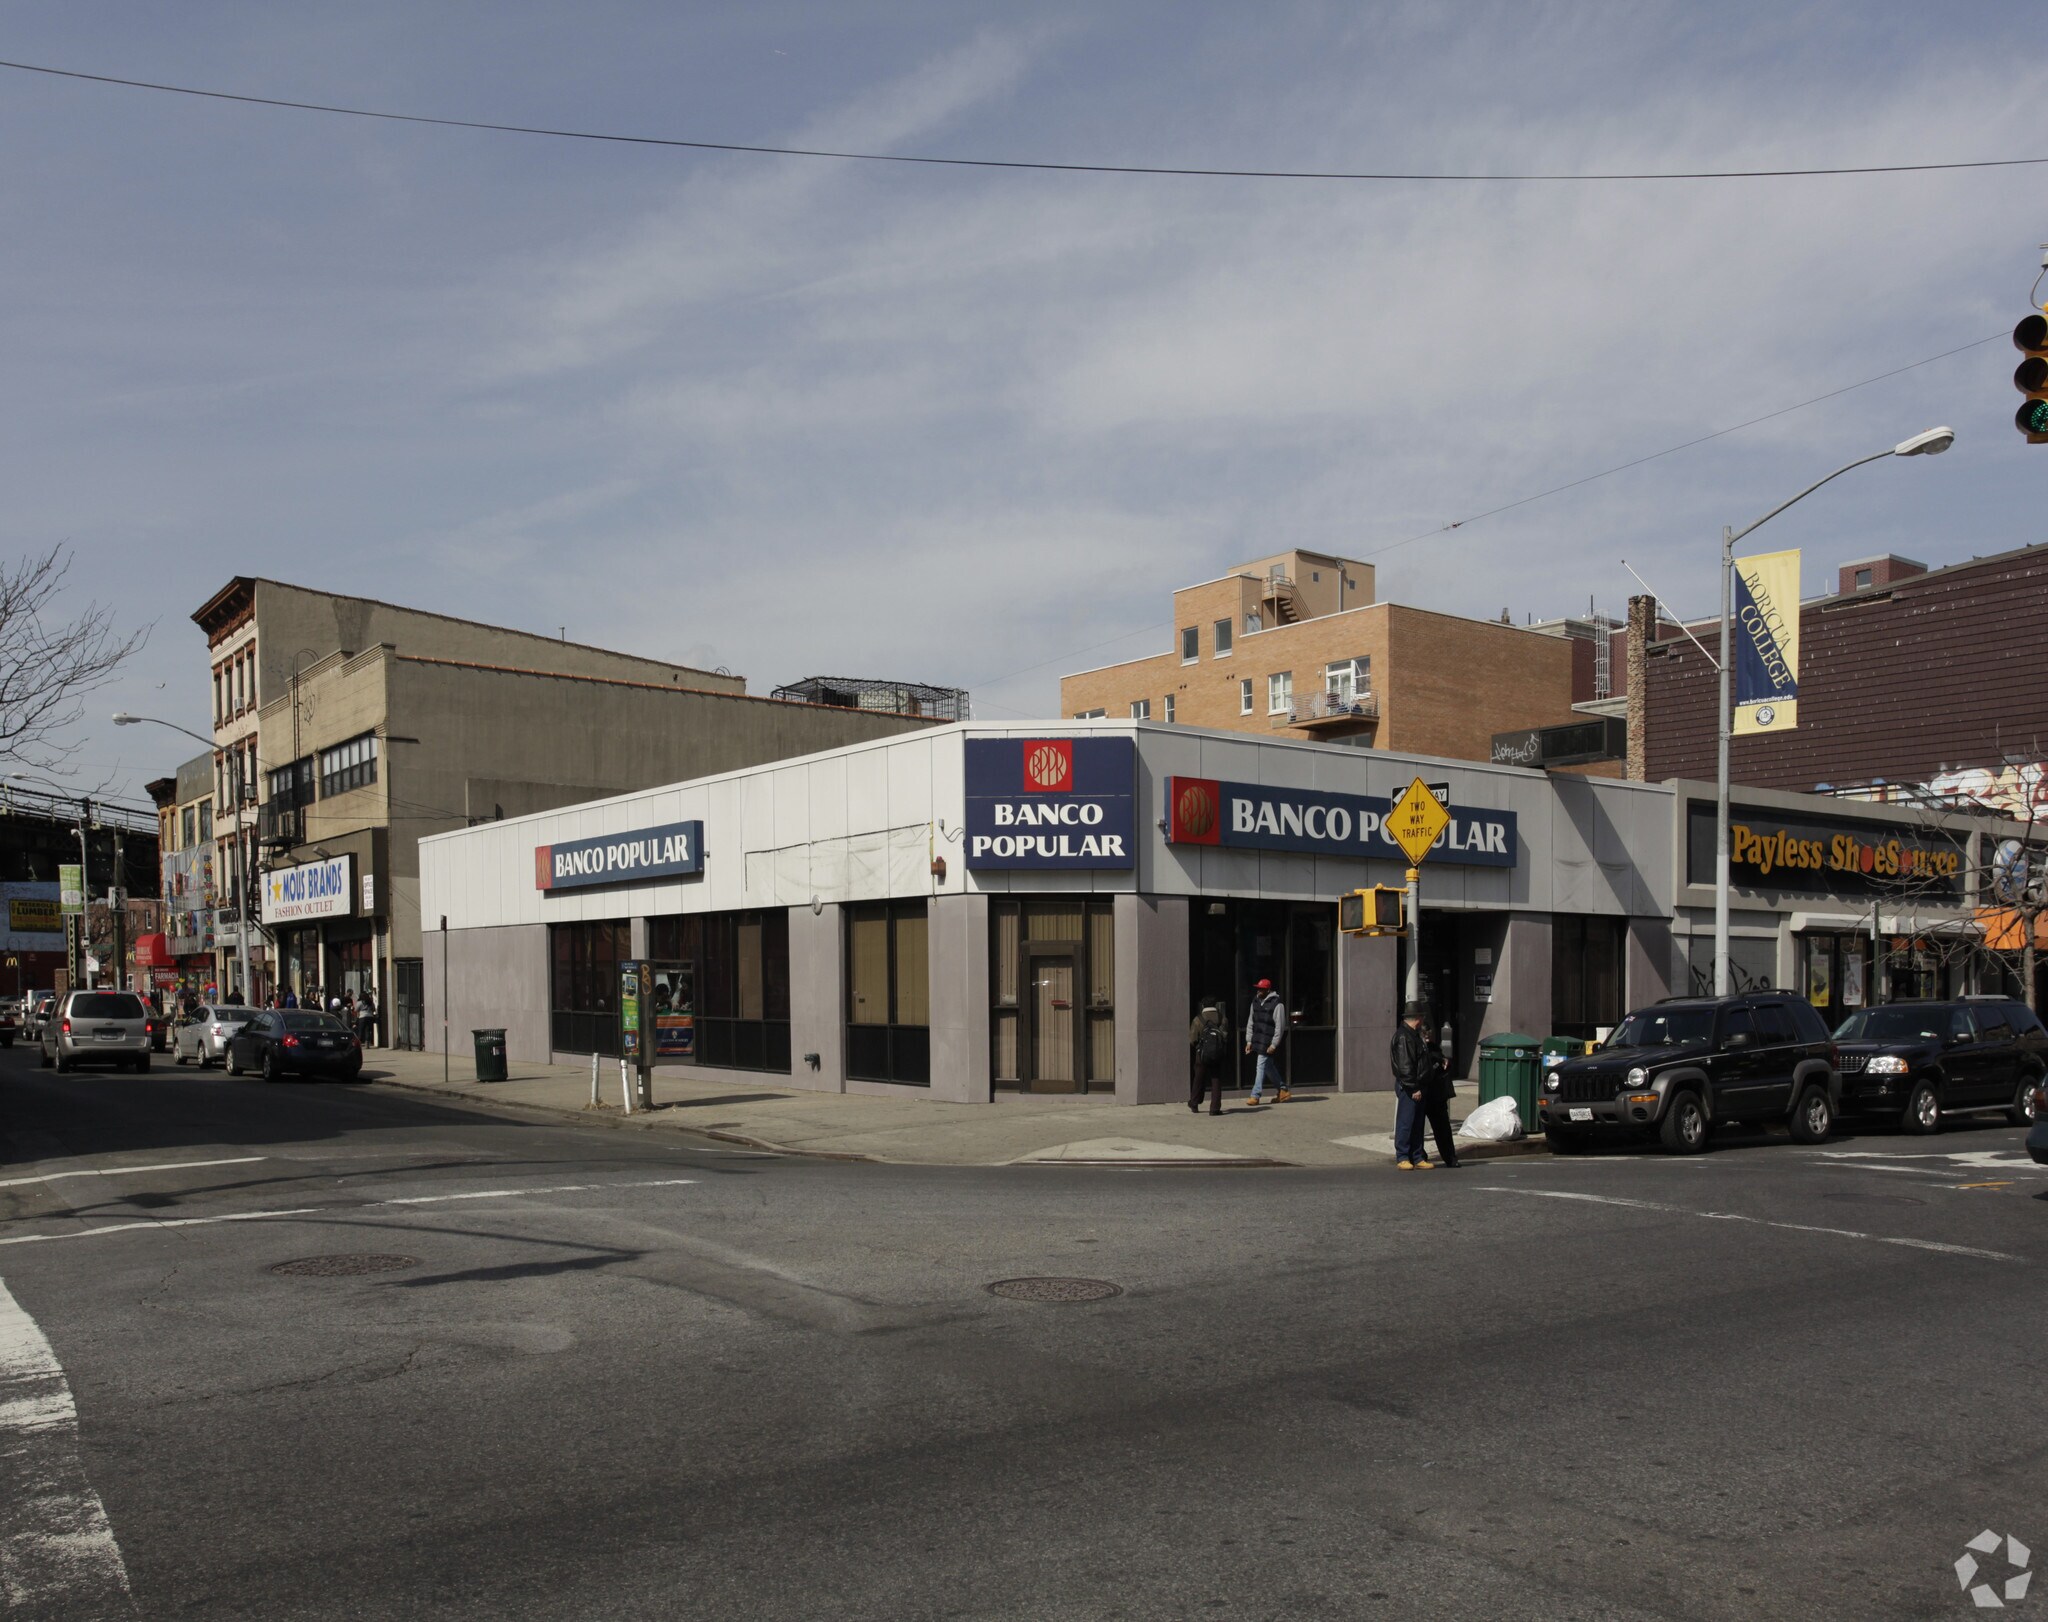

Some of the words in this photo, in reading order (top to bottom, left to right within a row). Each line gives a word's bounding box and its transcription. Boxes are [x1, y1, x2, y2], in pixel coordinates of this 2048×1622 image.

[1744, 572, 1791, 651] BORICUA
[1741, 605, 1791, 688] COLLEGE
[995, 803, 1103, 826] BANCO
[1410, 801, 1425, 812] TWO
[1232, 798, 1351, 841] BANCO
[1359, 810, 1507, 853] POLAR
[1410, 815, 1424, 825] WAY
[1402, 827, 1432, 839] TRAFFIC
[555, 847, 604, 878] BANCO
[607, 834, 689, 871] POPULAR
[972, 835, 1126, 857] POPULAR
[1731, 824, 1823, 875] Payless
[308, 862, 342, 899] BRANDS
[17, 907, 55, 916] LUMBER
[275, 905, 302, 918] FASHION
[305, 900, 334, 914] OUTLET
